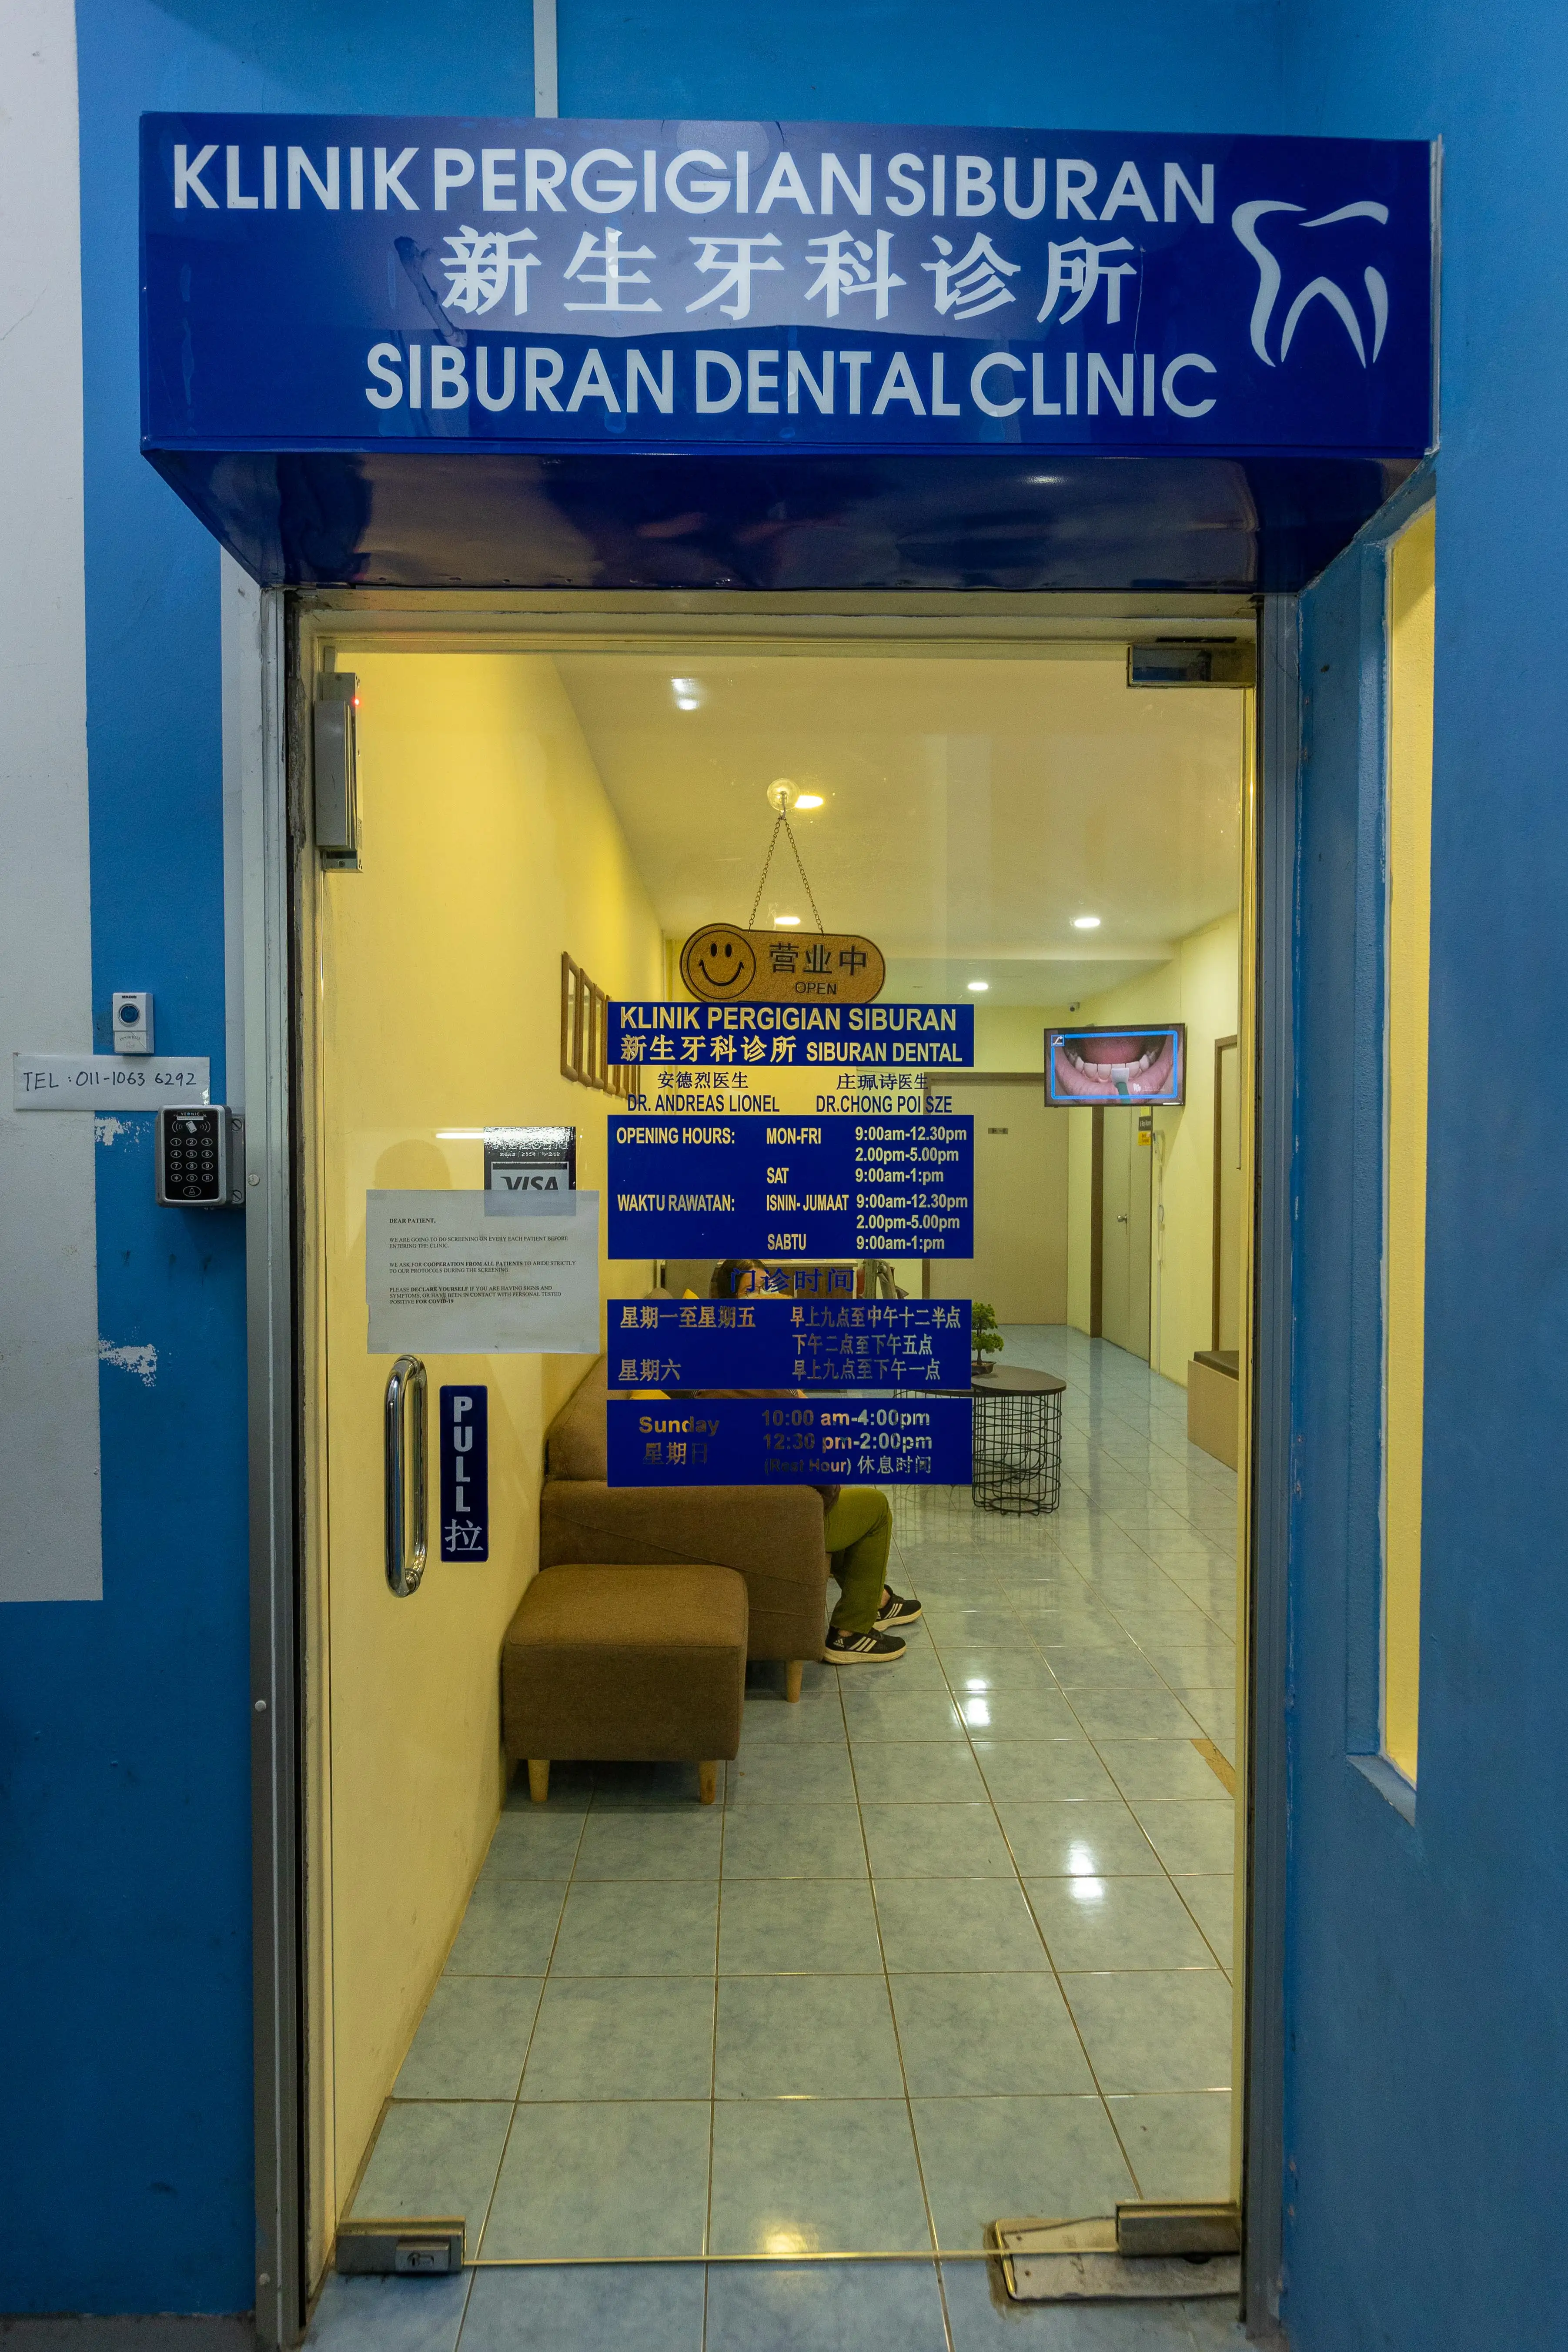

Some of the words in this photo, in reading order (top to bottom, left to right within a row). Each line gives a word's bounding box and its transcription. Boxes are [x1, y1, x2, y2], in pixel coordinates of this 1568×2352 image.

[174, 144, 420, 211] KLINIK
[434, 147, 872, 216] PERGIGIAN
[886, 152, 1214, 224] SIBURAN
[440, 224, 1138, 325] 新生牙科诊所
[365, 342, 674, 414] SIBURAN
[696, 349, 961, 416] DENTAL
[970, 352, 1218, 418] CLINIC
[770, 942, 867, 976] 营业中
[795, 981, 837, 995] OPEN
[621, 1007, 700, 1029] KLINIK
[708, 1007, 840, 1030] PERGIGIAN
[849, 1009, 956, 1031] SIBURAN
[621, 1034, 797, 1062] 新生牙科诊所
[807, 1042, 887, 1062] SIBURAN
[893, 1043, 963, 1062] DENTAL
[23, 1072, 59, 1091] TEL
[155, 1073, 197, 1087] 6292
[657, 1071, 749, 1089] 安德烈医生
[836, 1073, 928, 1091] 庄珮诗医生
[628, 1094, 651, 1112] DR.
[655, 1094, 725, 1112] ANDREAS
[729, 1095, 780, 1112] LIONEL
[816, 1095, 892, 1113] DR.CHONG
[897, 1096, 921, 1113] POI
[925, 1096, 953, 1113] SZE
[616, 1127, 679, 1144] OPENING
[682, 1127, 735, 1144] HOURS:
[766, 1128, 822, 1144] MON-FRI
[855, 1126, 967, 1141] 9:00am-12.30pm
[855, 1148, 959, 1163] 2.00pm-5.00pm
[500, 1176, 558, 1190] VISA
[766, 1167, 789, 1184] SAT
[855, 1169, 944, 1184] 9:00am-1:pm
[617, 1194, 665, 1211] WAKTU
[669, 1194, 735, 1211] RAWATAN:
[766, 1194, 800, 1211] ISNIN-
[803, 1194, 849, 1211] JUMAAT
[856, 1194, 968, 1211] 9:00am-12.30pm
[856, 1214, 960, 1232] 2.00pm-5.00pm
[767, 1234, 806, 1250] SABTU
[856, 1235, 945, 1253] 9:00am-1:pm
[731, 1268, 855, 1293] 门诊时间
[620, 1306, 756, 1329] 星期一至星期五
[790, 1305, 962, 1329] 早上九点至中午十二半点
[792, 1333, 933, 1355] 下午二点至下午五点
[618, 1358, 682, 1382] 星期六
[792, 1358, 941, 1381] 早上九点至下午一点
[639, 1416, 720, 1437] Sunday
[761, 1409, 814, 1426] 10:00
[820, 1409, 930, 1430] am-4:00pm
[763, 1433, 815, 1450] 12:30
[822, 1433, 933, 1453] pm-2:00pm
[454, 1396, 473, 1512] PULL
[642, 1442, 707, 1465] 星期日
[809, 1458, 852, 1475] Hour)
[857, 1455, 931, 1474] 休息时间
[445, 1519, 484, 1552] 拉
